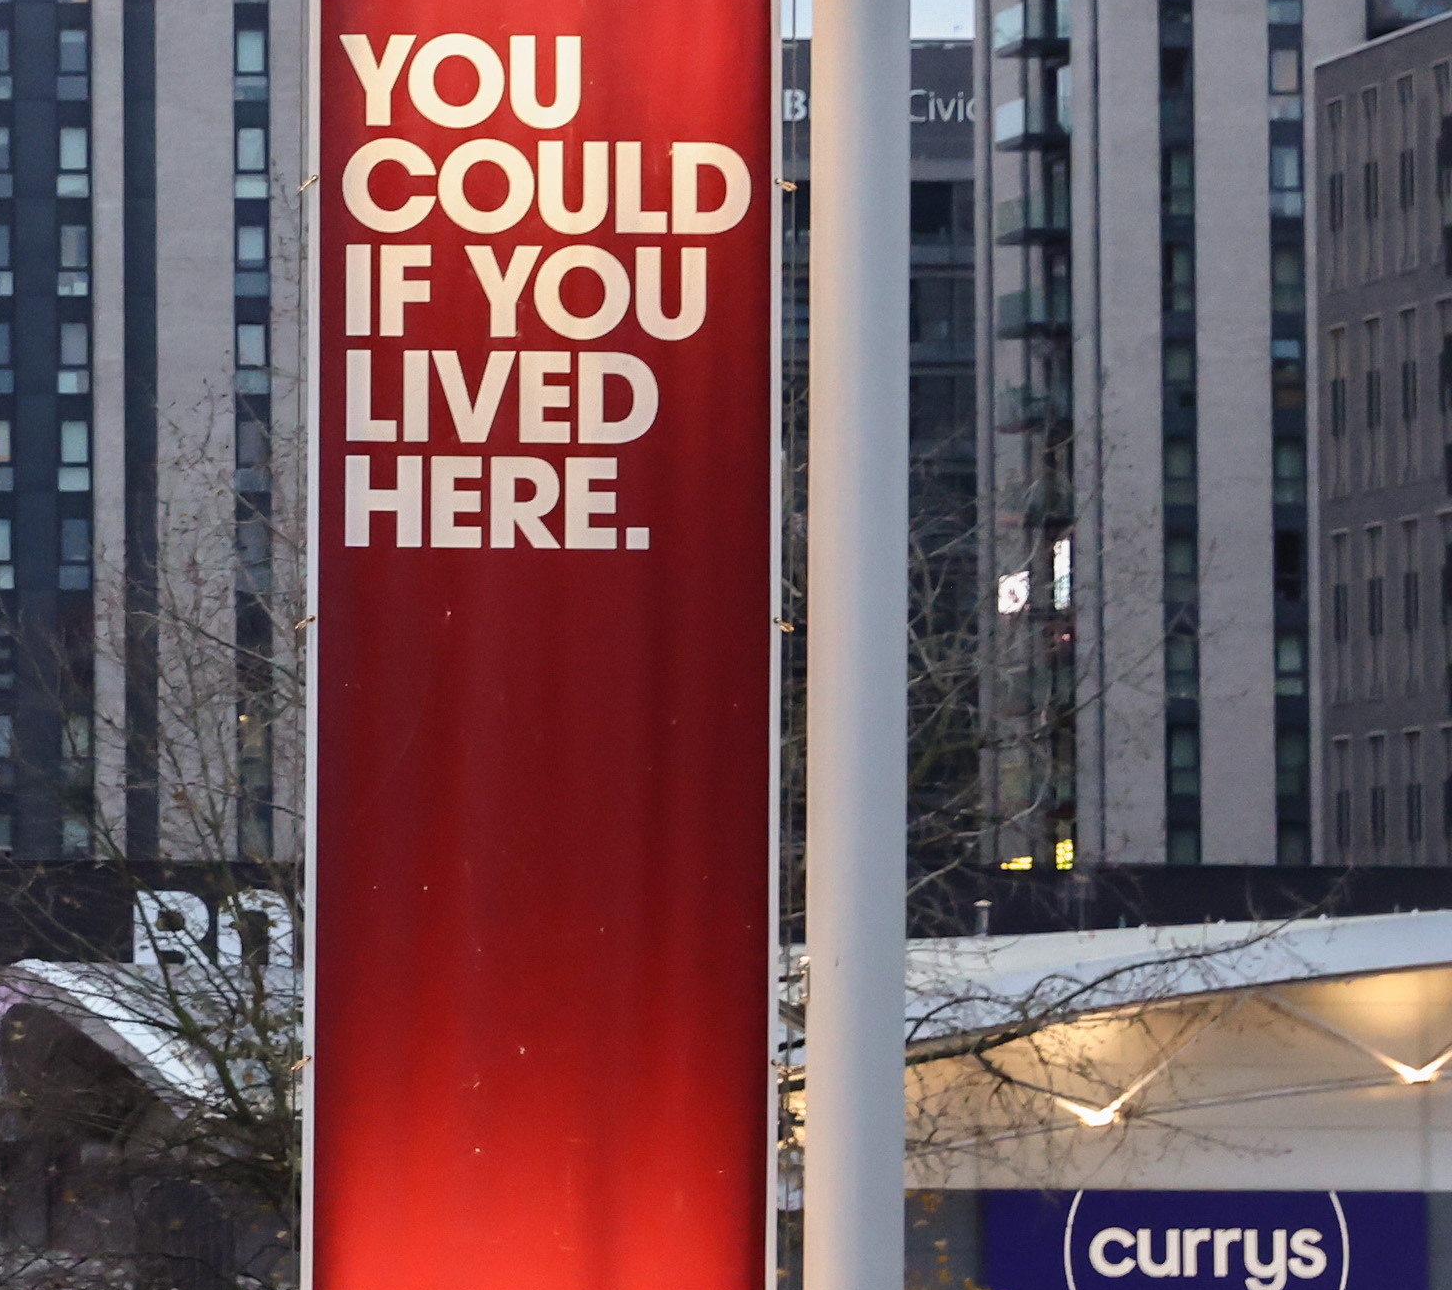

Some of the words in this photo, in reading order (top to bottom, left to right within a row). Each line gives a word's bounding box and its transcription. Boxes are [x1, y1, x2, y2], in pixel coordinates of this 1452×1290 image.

[340, 33, 581, 129] YOU
[343, 138, 751, 234] COULD
[346, 244, 431, 340] IF
[465, 244, 707, 340] YOU
[346, 350, 658, 443] LIVED
[345, 455, 650, 550] HERE.
